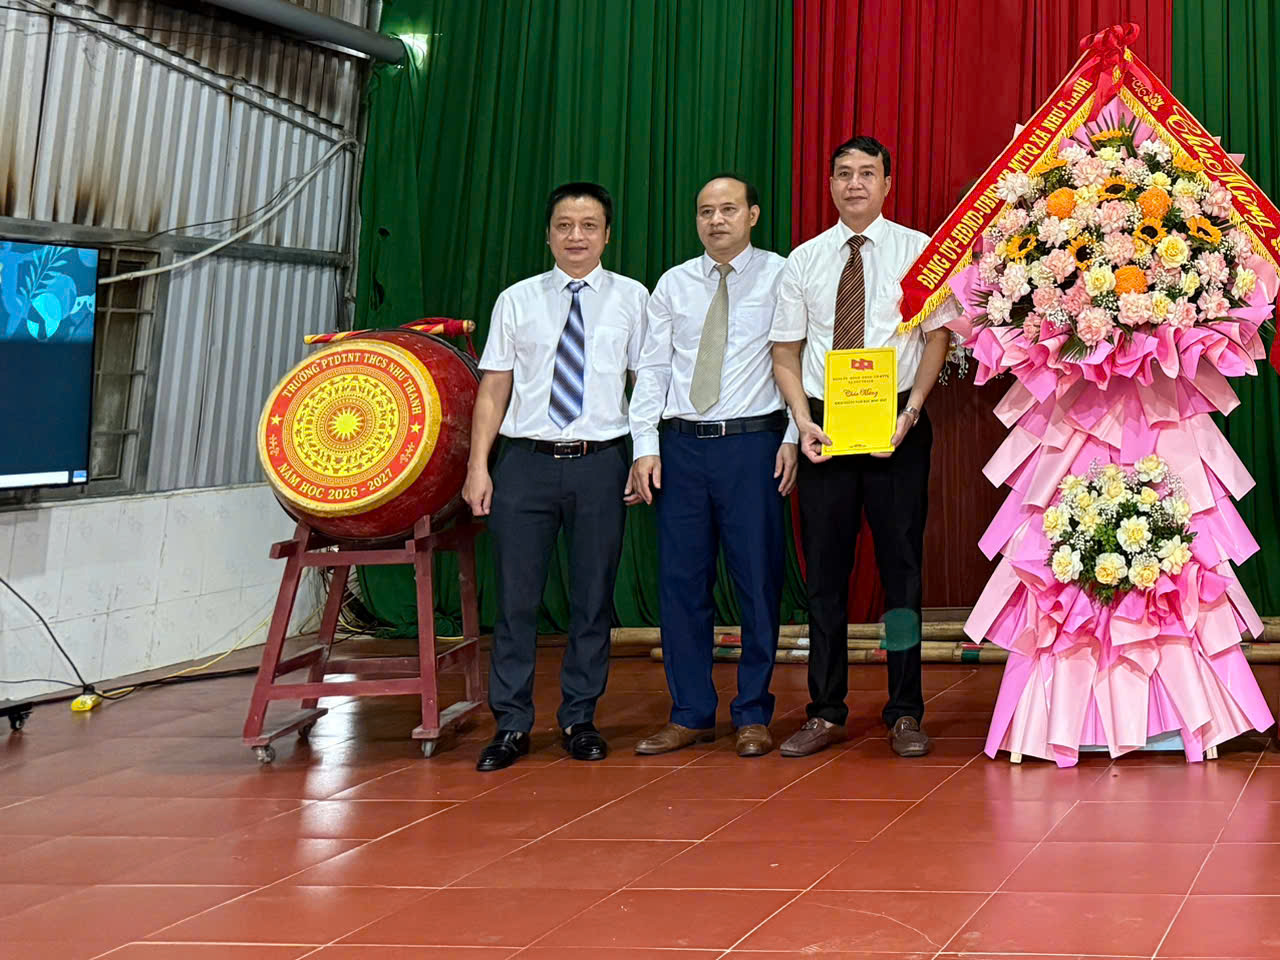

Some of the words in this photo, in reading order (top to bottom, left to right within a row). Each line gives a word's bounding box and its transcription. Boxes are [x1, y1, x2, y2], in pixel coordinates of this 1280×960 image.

[917, 253, 951, 290] ĐẢNG
[1029, 126, 1052, 148] XÃ
[1041, 105, 1067, 132] NHƯ
[1166, 105, 1222, 171] Chúc
[1207, 159, 1276, 238] Mừng
[321, 352, 361, 369] PTDTNT
[363, 352, 388, 368] THCS
[388, 362, 410, 381] NHƯ
[403, 378, 422, 415] THANH
[299, 481, 325, 498] HỌC
[328, 486, 359, 500] 2026
[367, 468, 393, 491] 2027
